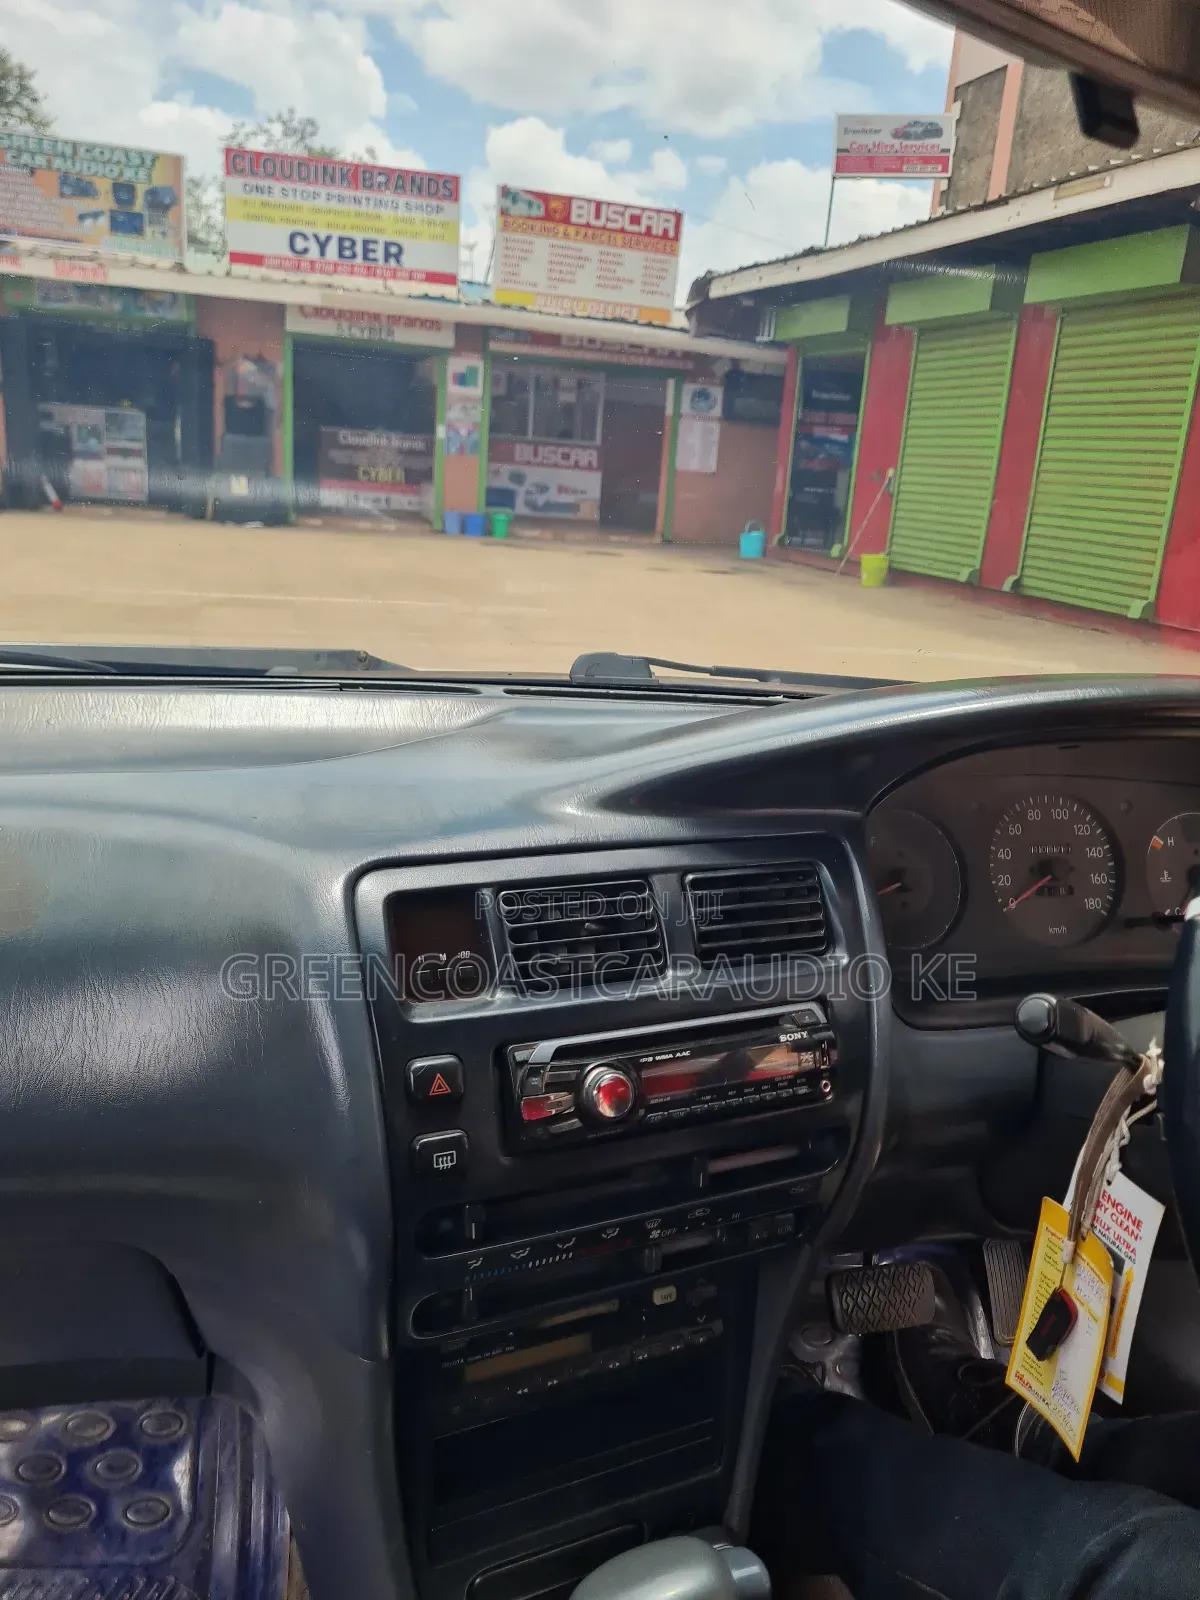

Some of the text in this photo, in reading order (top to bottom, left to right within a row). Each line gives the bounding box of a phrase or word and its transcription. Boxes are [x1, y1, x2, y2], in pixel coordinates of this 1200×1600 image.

[230, 152, 455, 199] CLOUDINK BRANDS
[242, 182, 276, 199] ONE
[281, 187, 323, 203] STOP
[325, 192, 400, 212] PRINTING
[404, 201, 445, 216] SHOP
[569, 198, 677, 239] BUSCAR
[288, 230, 405, 266] CYBER
[1028, 809, 1041, 821] 80
[1050, 808, 1069, 820] 100
[1008, 824, 1022, 836] 60
[1073, 824, 1091, 836] 120
[1167, 836, 1175, 847] H
[997, 848, 1012, 860] 40
[1086, 846, 1104, 859] 140
[997, 874, 1011, 886] 20
[1090, 872, 1107, 885] 160
[1084, 897, 1102, 910] 180
[1048, 924, 1067, 935] km/h
[418, 954, 425, 963] H
[439, 952, 447, 961] M
[778, 1031, 809, 1043] SONY
[655, 1053, 674, 1062] WMA
[675, 1050, 691, 1058] AAC
[1101, 1189, 1144, 1233] ENGINE
[661, 1227, 679, 1239] OFF
[1097, 1227, 1137, 1265] NATURAL GAS
[1113, 1231, 1137, 1257] ULTRA
